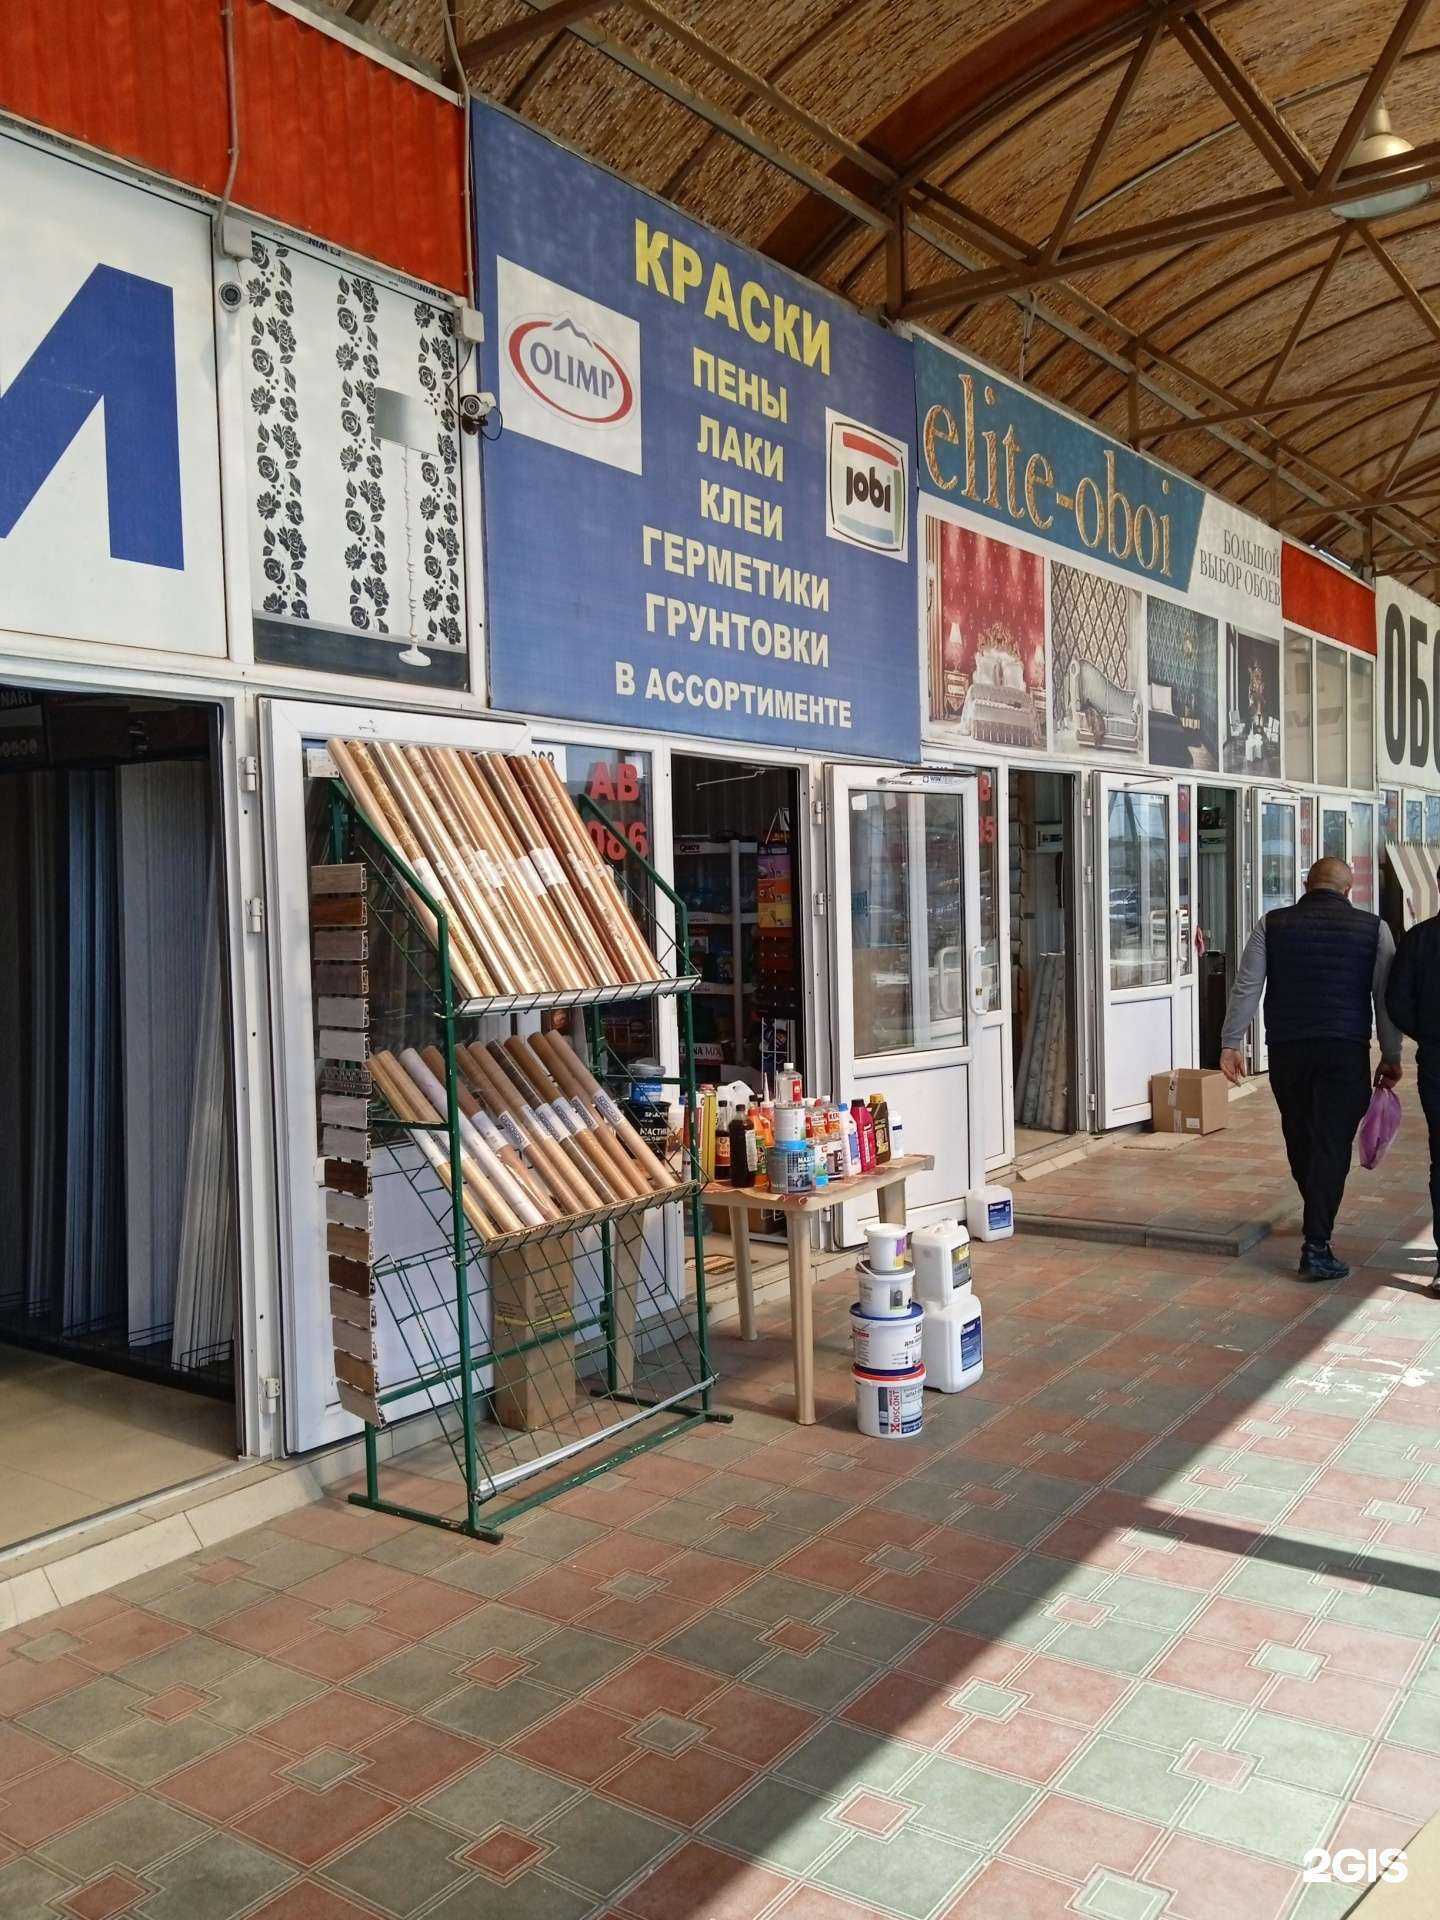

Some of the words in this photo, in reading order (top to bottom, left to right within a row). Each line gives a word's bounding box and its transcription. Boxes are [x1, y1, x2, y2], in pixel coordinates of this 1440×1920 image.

[634, 218, 831, 376] КРАСКИ
[529, 341, 615, 400] OLIMP
[693, 347, 788, 424] ПЕНЫ
[697, 415, 785, 482] ЛАКИ
[922, 374, 1173, 578] elite-oboi
[700, 477, 784, 542] КЛЕИ
[642, 525, 829, 612] ГЕРМЕТИКИ
[1200, 548, 1242, 590] ВЫБОР
[1244, 569, 1280, 606] ОБОЕВ
[1223, 529, 1280, 578] БОЛЬШОЙ
[645, 592, 829, 668] ГРУНТОВКИ
[615, 661, 636, 697] В
[644, 665, 853, 730] АССОРТИМЕНТЕ
[1384, 602, 1440, 774] ОБ
